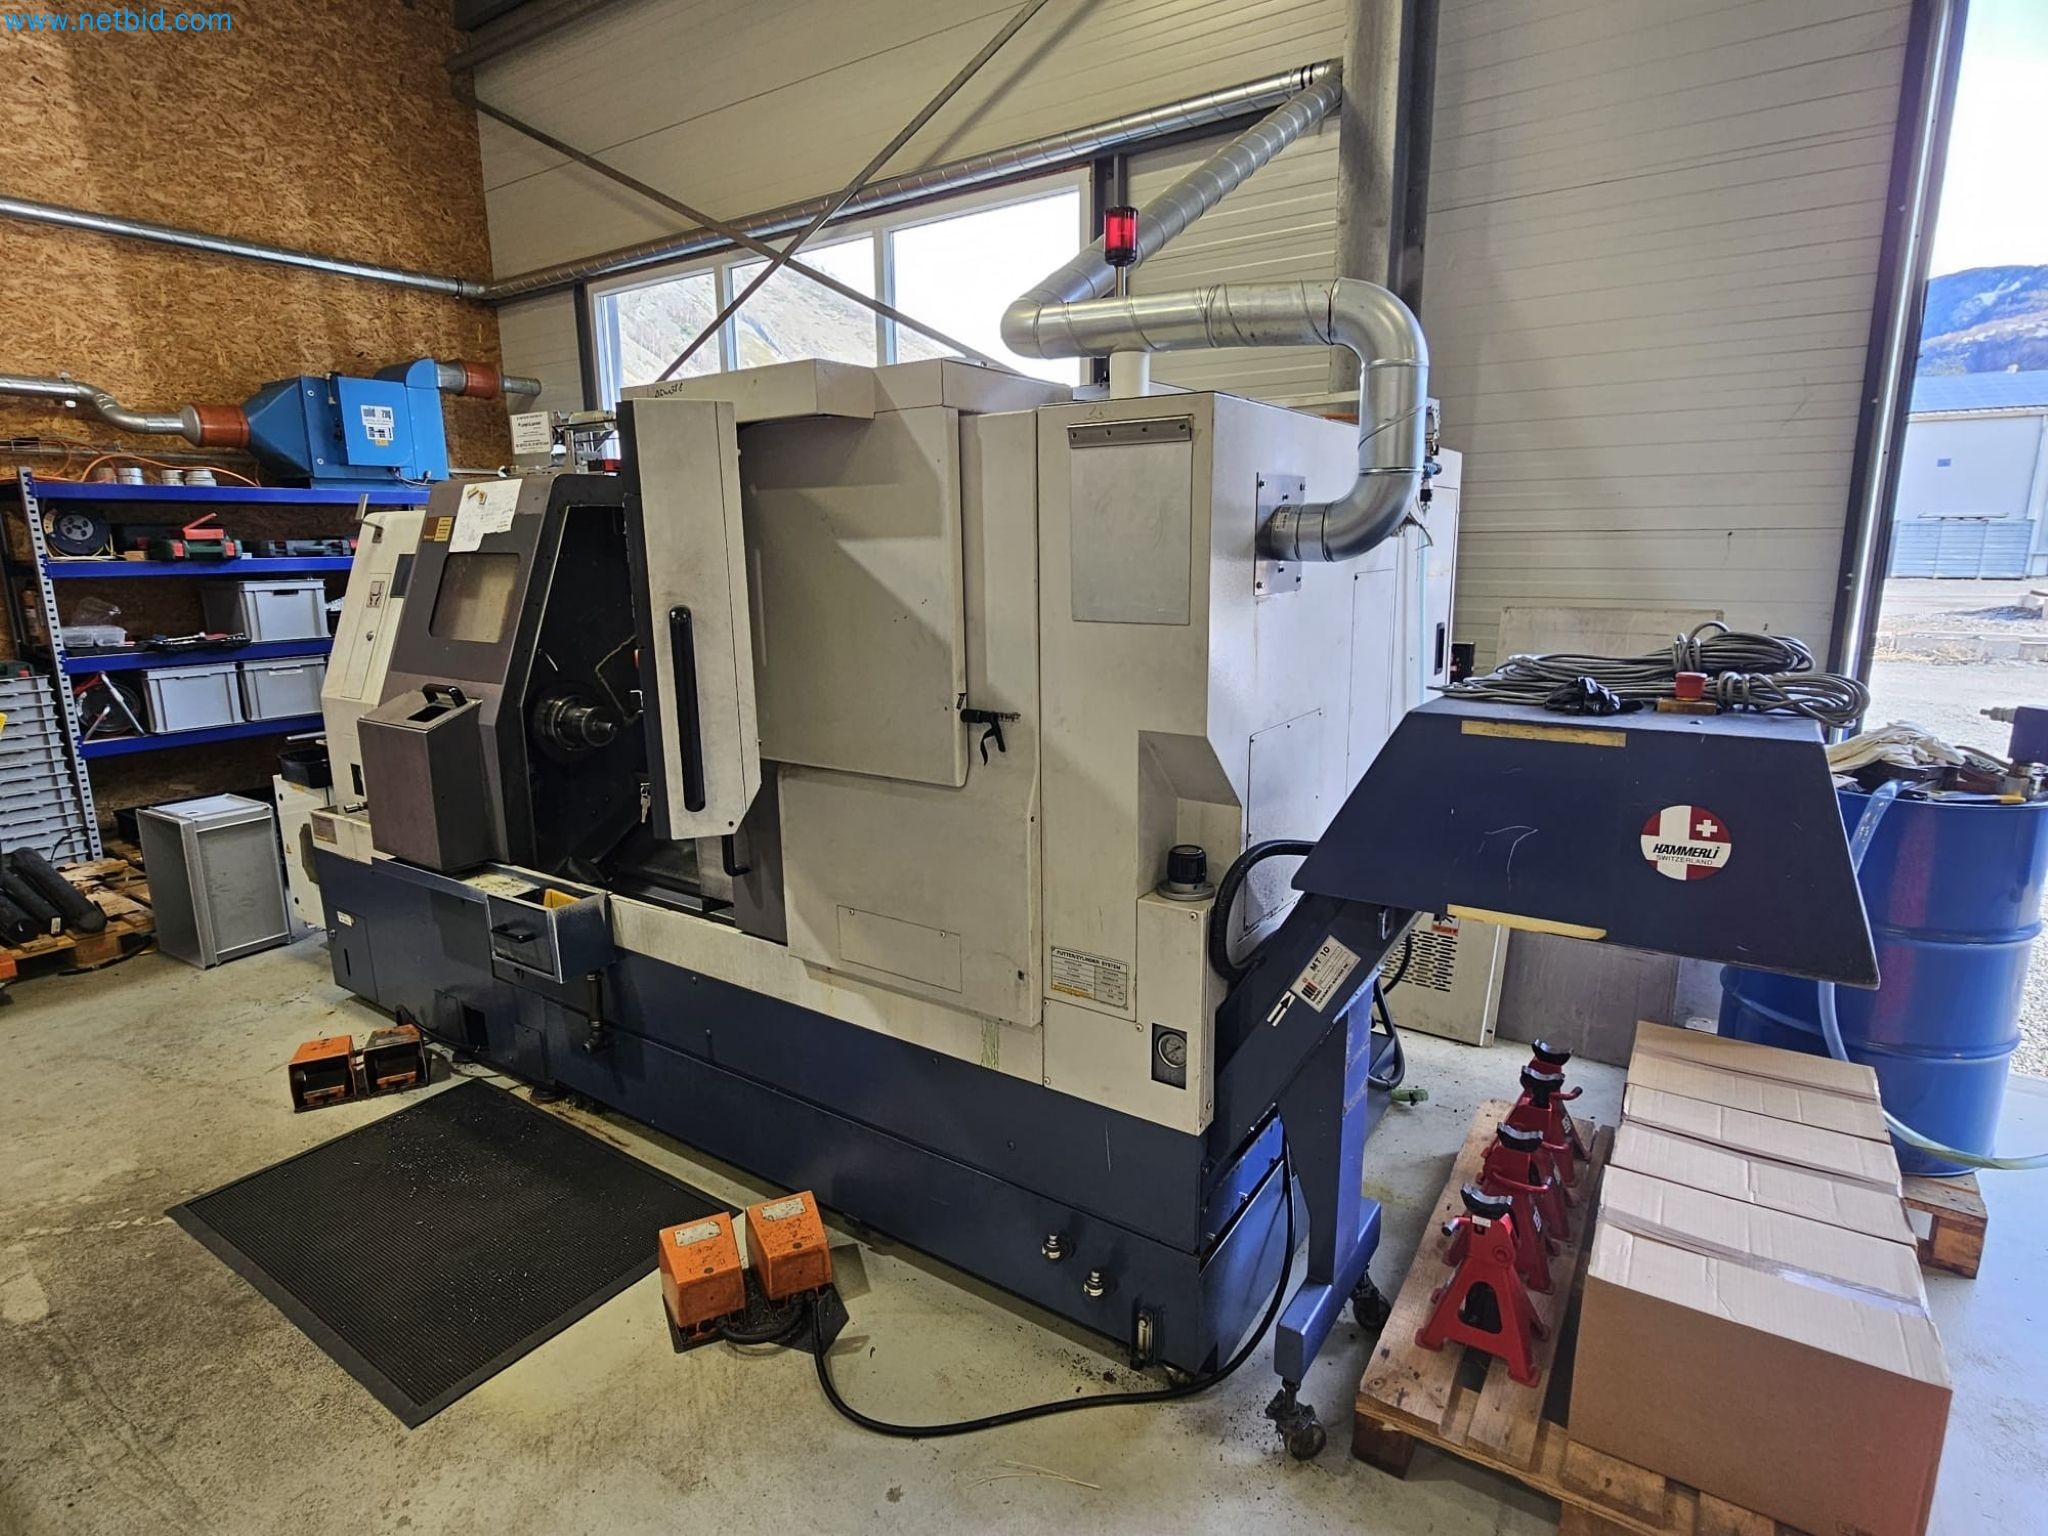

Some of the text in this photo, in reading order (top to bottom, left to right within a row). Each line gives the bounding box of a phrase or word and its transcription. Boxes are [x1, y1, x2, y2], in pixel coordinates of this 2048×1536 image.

[1656, 855, 1713, 865] SWITZERLAND
[1101, 961, 1121, 970] SYSTEM
[1310, 957, 1321, 971] MT
